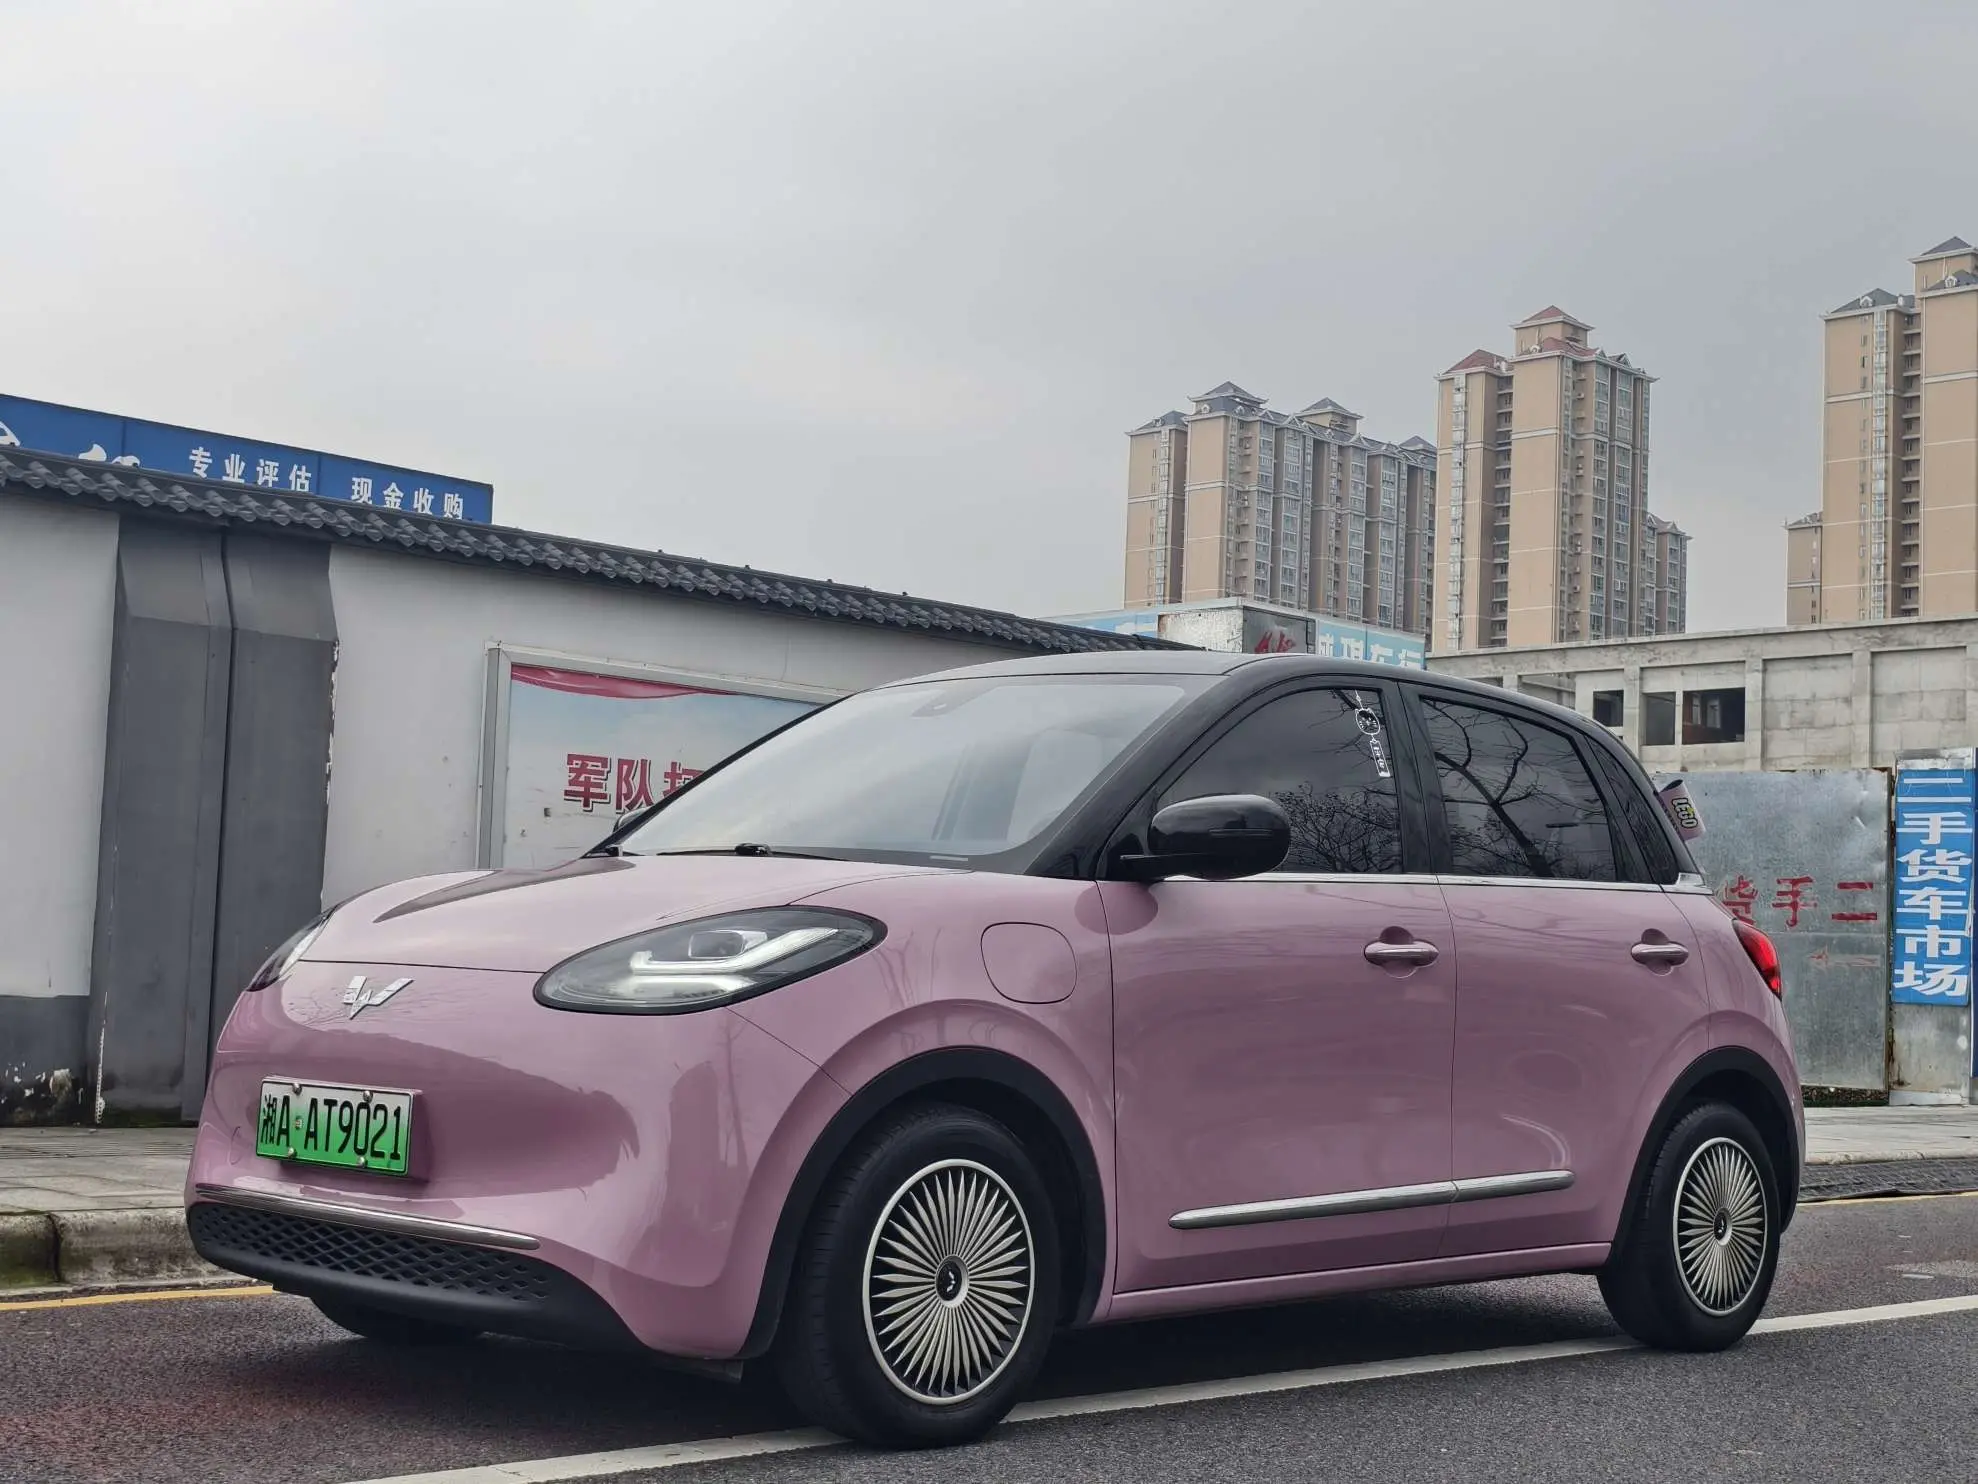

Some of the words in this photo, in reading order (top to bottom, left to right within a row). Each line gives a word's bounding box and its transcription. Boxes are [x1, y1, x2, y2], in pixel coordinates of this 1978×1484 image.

[189, 446, 312, 492] 专业评估
[351, 476, 464, 520] 现金收购
[1671, 797, 1699, 829] LEGO
[1893, 777, 1973, 997] 二手货车市场
